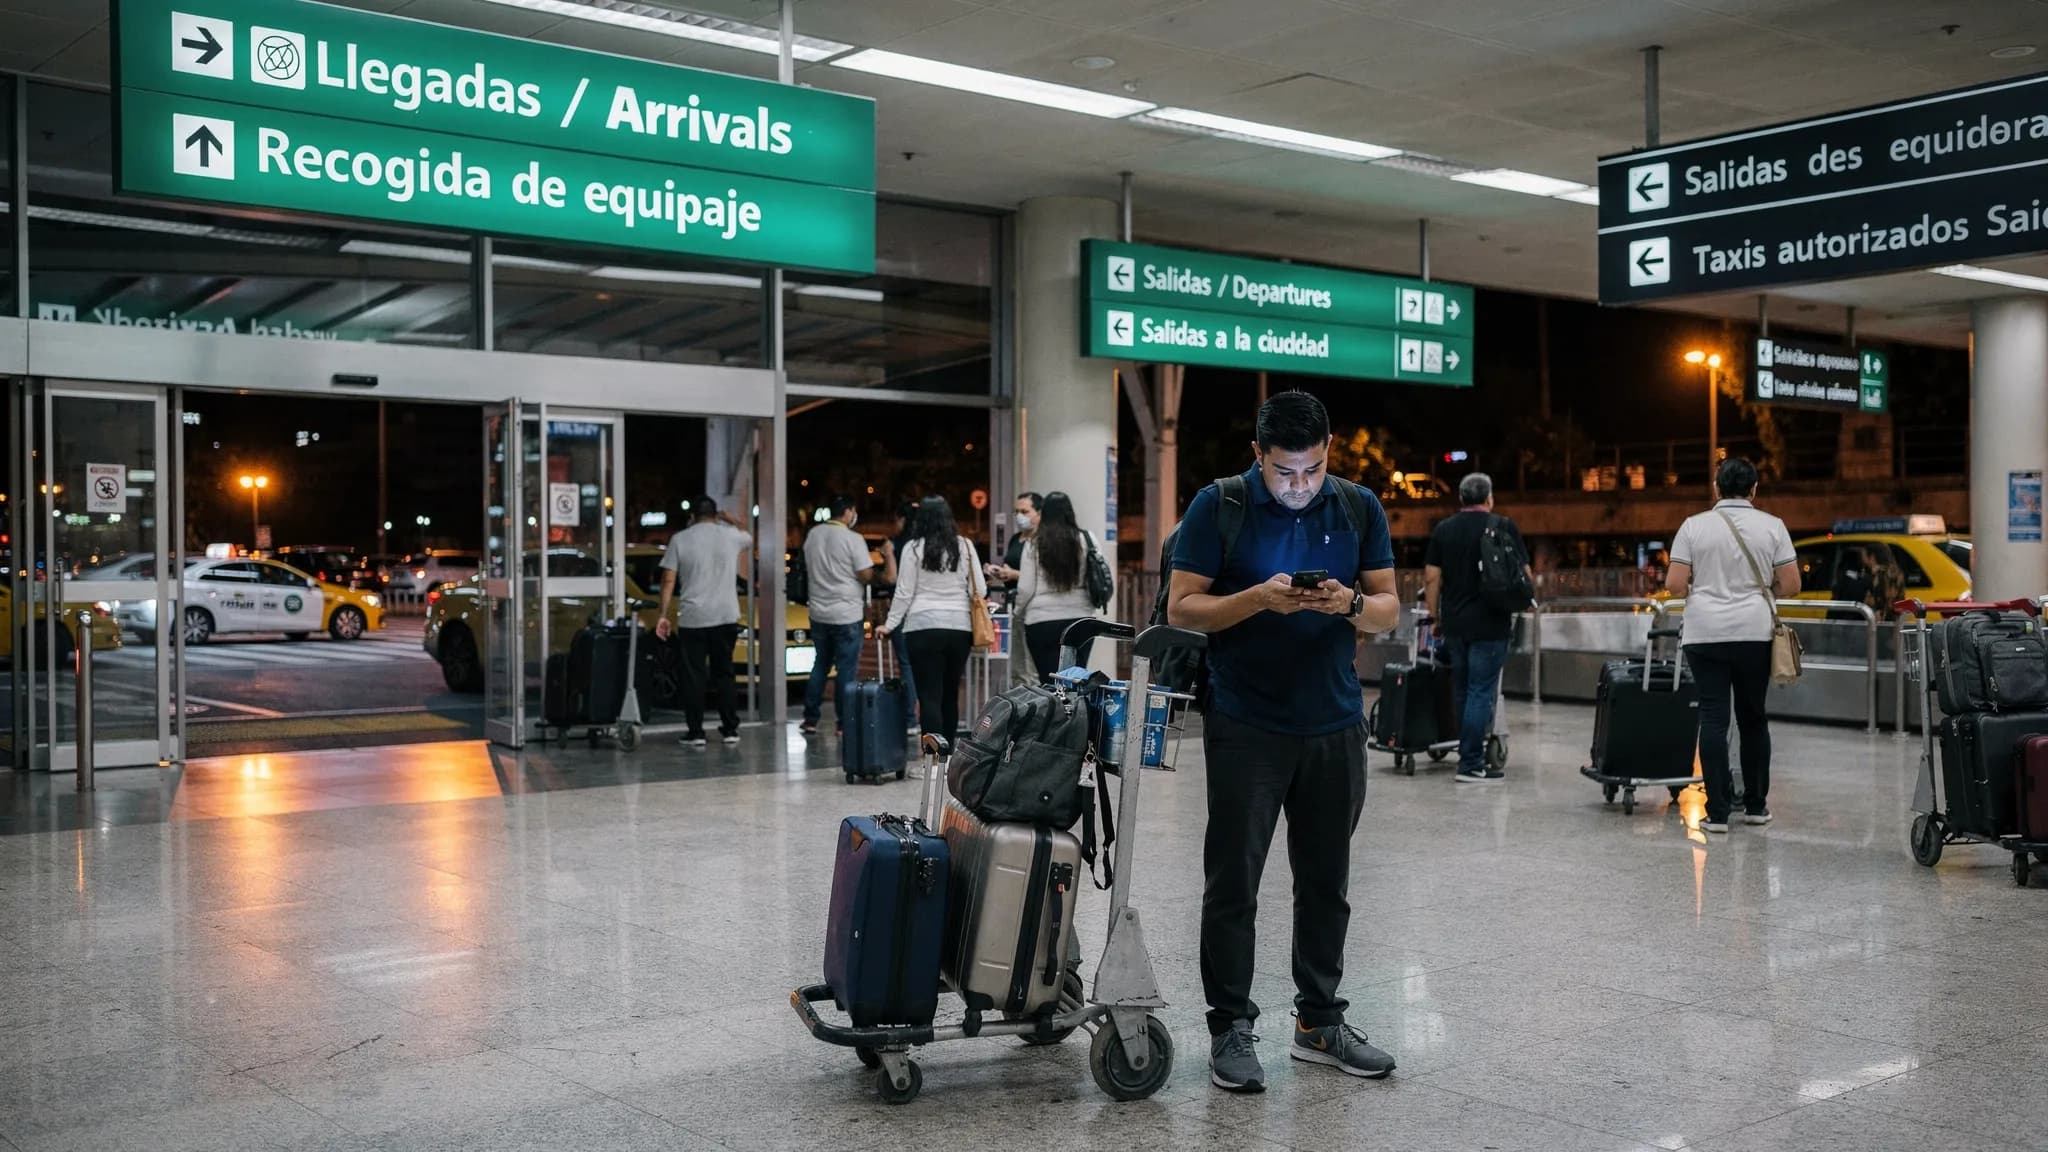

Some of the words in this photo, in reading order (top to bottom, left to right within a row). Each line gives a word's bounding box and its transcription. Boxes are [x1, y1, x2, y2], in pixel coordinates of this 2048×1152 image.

[317, 40, 541, 117] Llegadas
[560, 78, 589, 128] /
[606, 86, 794, 154] Arrivals
[258, 127, 491, 202] Recogida
[512, 161, 567, 208] de
[584, 179, 762, 240] equipaje
[1685, 155, 1789, 196] Salidas
[1808, 143, 1863, 176] des
[1692, 238, 1766, 276] Taxis
[1778, 213, 1969, 265] autorizados
[1143, 264, 1212, 296] Salidas
[1217, 274, 1229, 298] /
[1232, 275, 1332, 309] Departures
[1141, 317, 1208, 348] Salidas
[1214, 330, 1228, 349] a
[1234, 325, 1252, 351] la
